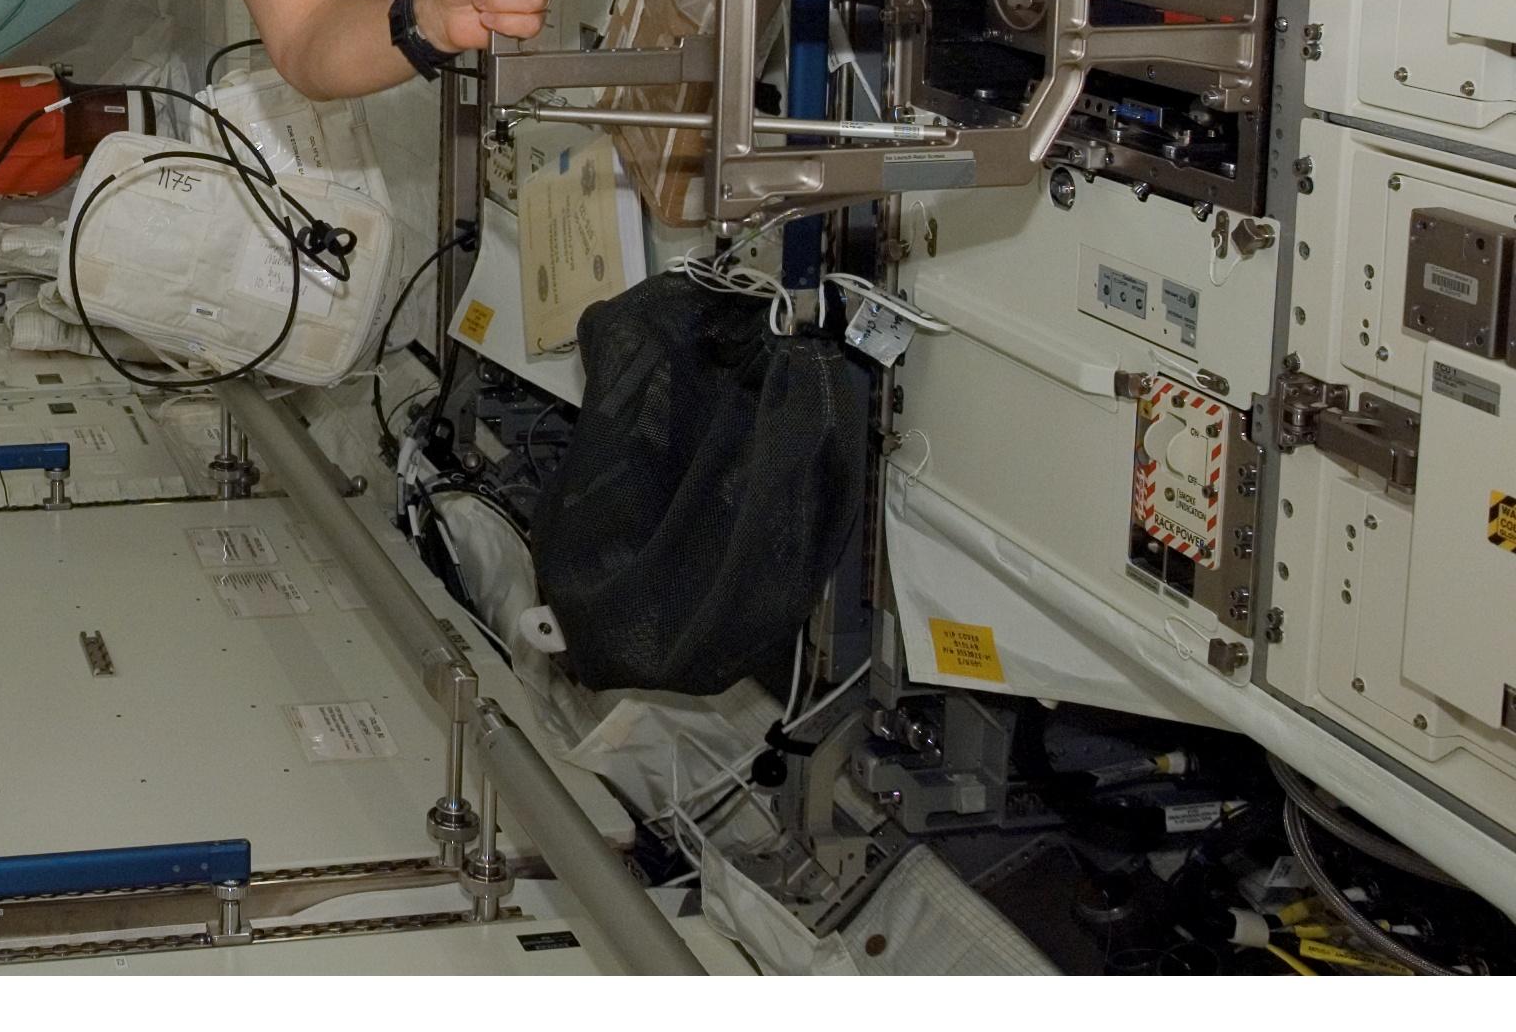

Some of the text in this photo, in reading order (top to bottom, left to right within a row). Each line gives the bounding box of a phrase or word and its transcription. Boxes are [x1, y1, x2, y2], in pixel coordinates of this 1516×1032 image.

[157, 167, 202, 193] 1175
[1190, 427, 1200, 438] ON
[1187, 474, 1198, 485] OFF
[1178, 489, 1196, 505] SMOKE
[1177, 501, 1207, 521] INDICATION
[1154, 513, 1205, 549] RACK POWER
[958, 633, 979, 642] COVER
